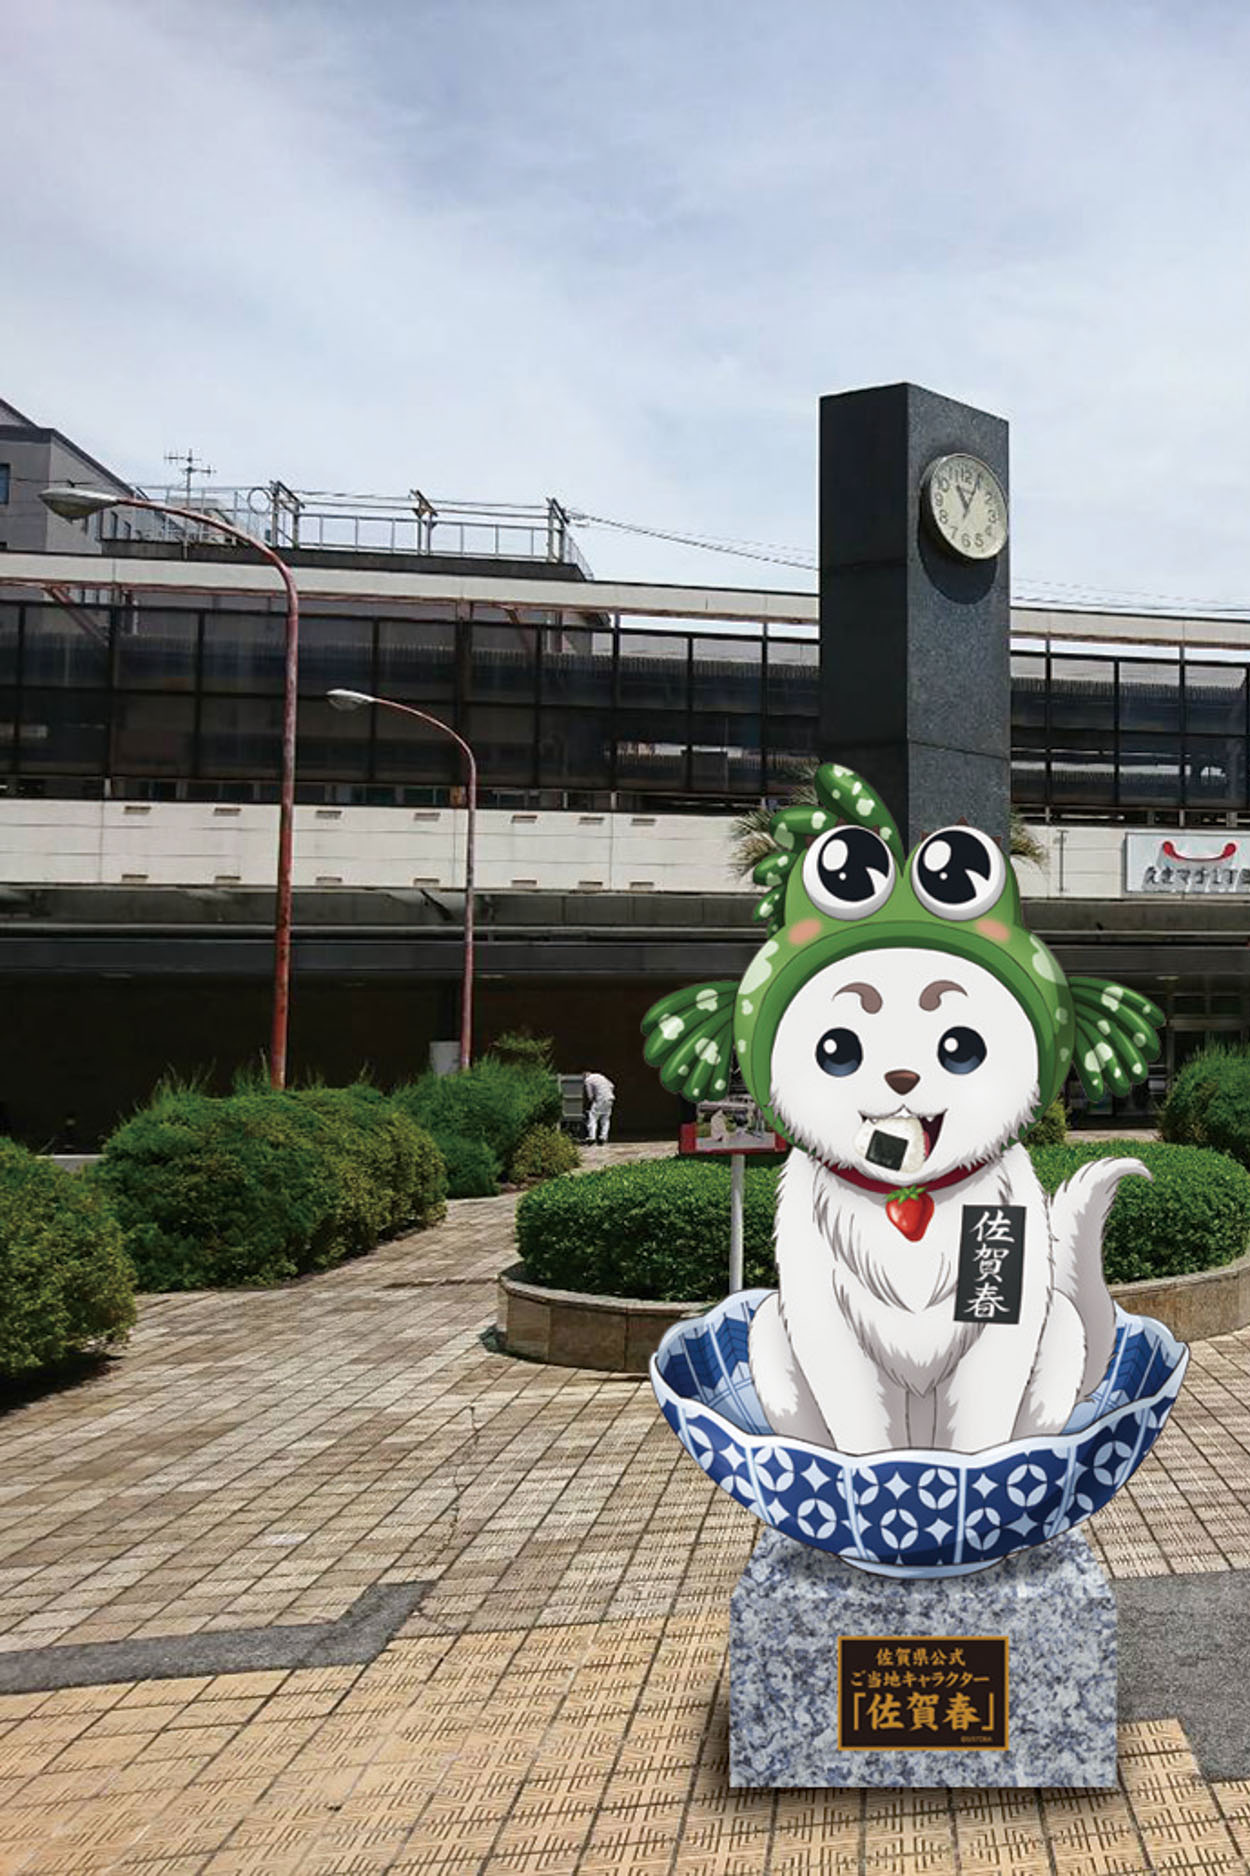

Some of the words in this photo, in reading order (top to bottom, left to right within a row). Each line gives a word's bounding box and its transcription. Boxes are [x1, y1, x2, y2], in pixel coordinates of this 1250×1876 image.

[961, 532, 971, 548] 6
[974, 532, 985, 547] 5
[963, 1209, 1016, 1319] 佐賀春
[875, 1647, 966, 1667] 佐賀県公式
[850, 1670, 989, 1688] ご当地キャラクター
[854, 1691, 994, 1731] 「佐賀春」
